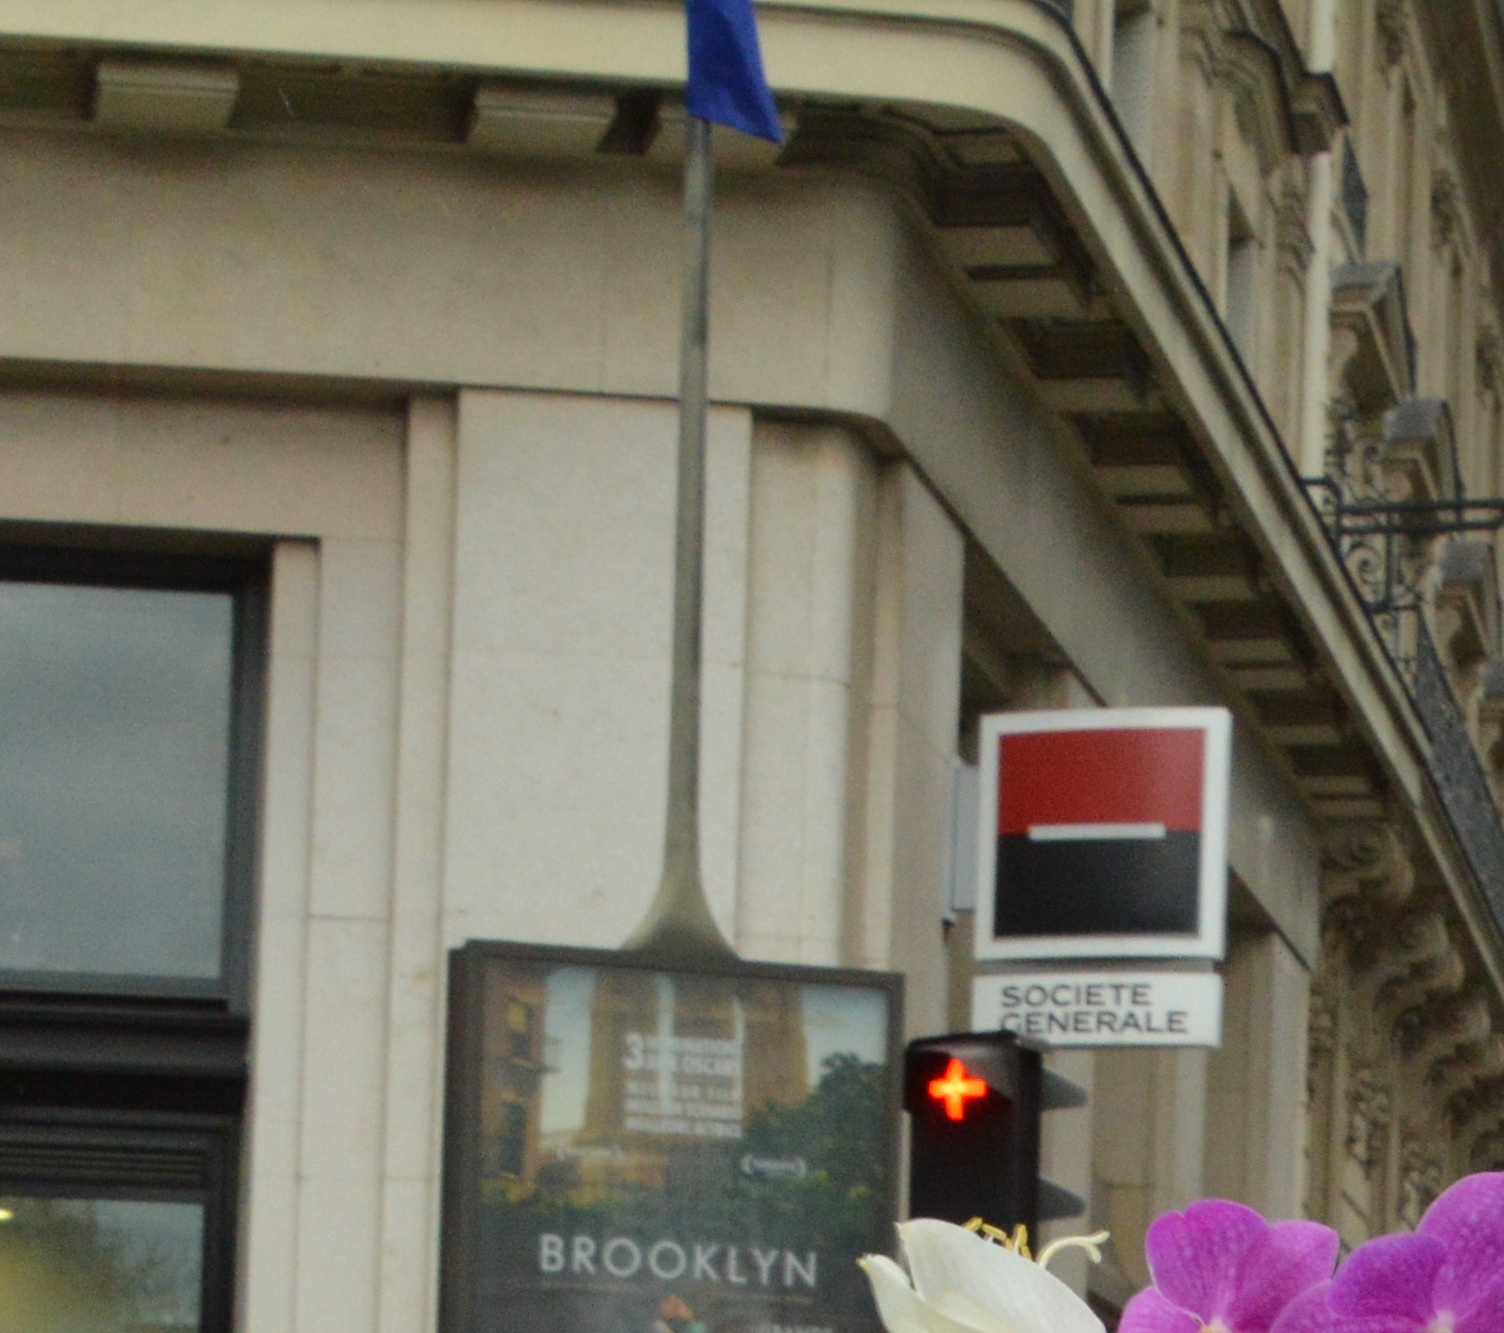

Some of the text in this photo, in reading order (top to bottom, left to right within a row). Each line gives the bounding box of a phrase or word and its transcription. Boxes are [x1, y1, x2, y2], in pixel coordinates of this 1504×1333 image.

[1001, 983, 1152, 1008] SOCIETE
[1001, 1009, 1188, 1034] GENERALE
[539, 1232, 818, 1288] BROOKLYN
